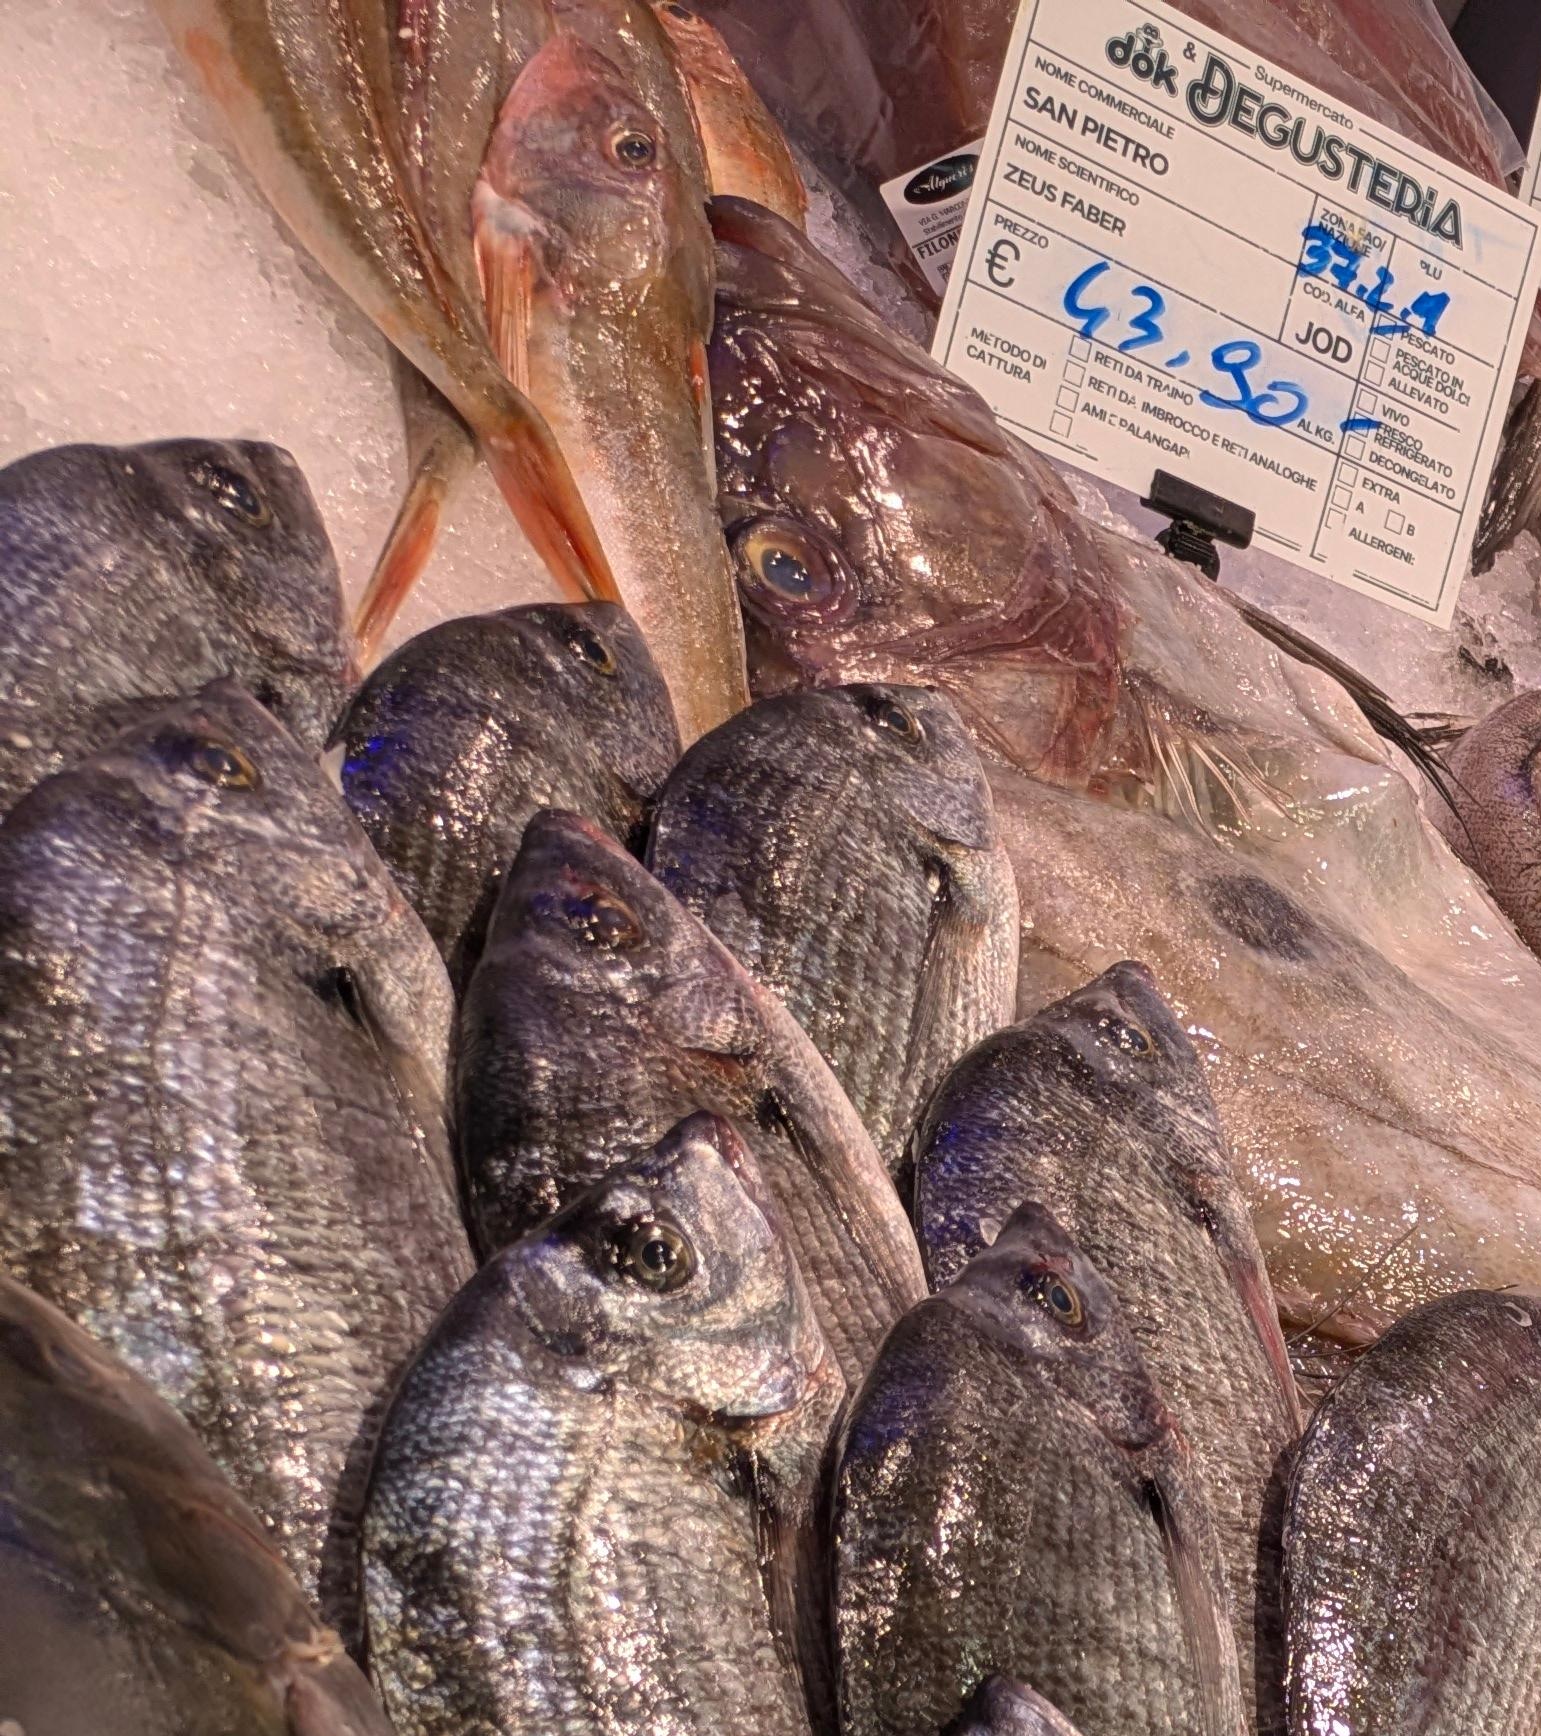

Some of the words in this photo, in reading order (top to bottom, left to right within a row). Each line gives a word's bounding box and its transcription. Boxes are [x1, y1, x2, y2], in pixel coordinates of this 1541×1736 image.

[1107, 32, 1178, 98] dok
[1182, 41, 1198, 62] &
[1253, 64, 1354, 132] Supermercato
[1022, 86, 1078, 136] SAN
[1082, 110, 1170, 177] PIETRO
[993, 212, 1049, 249] PREZZO
[1002, 163, 1056, 209] ZEUS
[1058, 189, 1127, 237] FABER
[984, 237, 1021, 288] €
[1294, 323, 1354, 363] JOD
